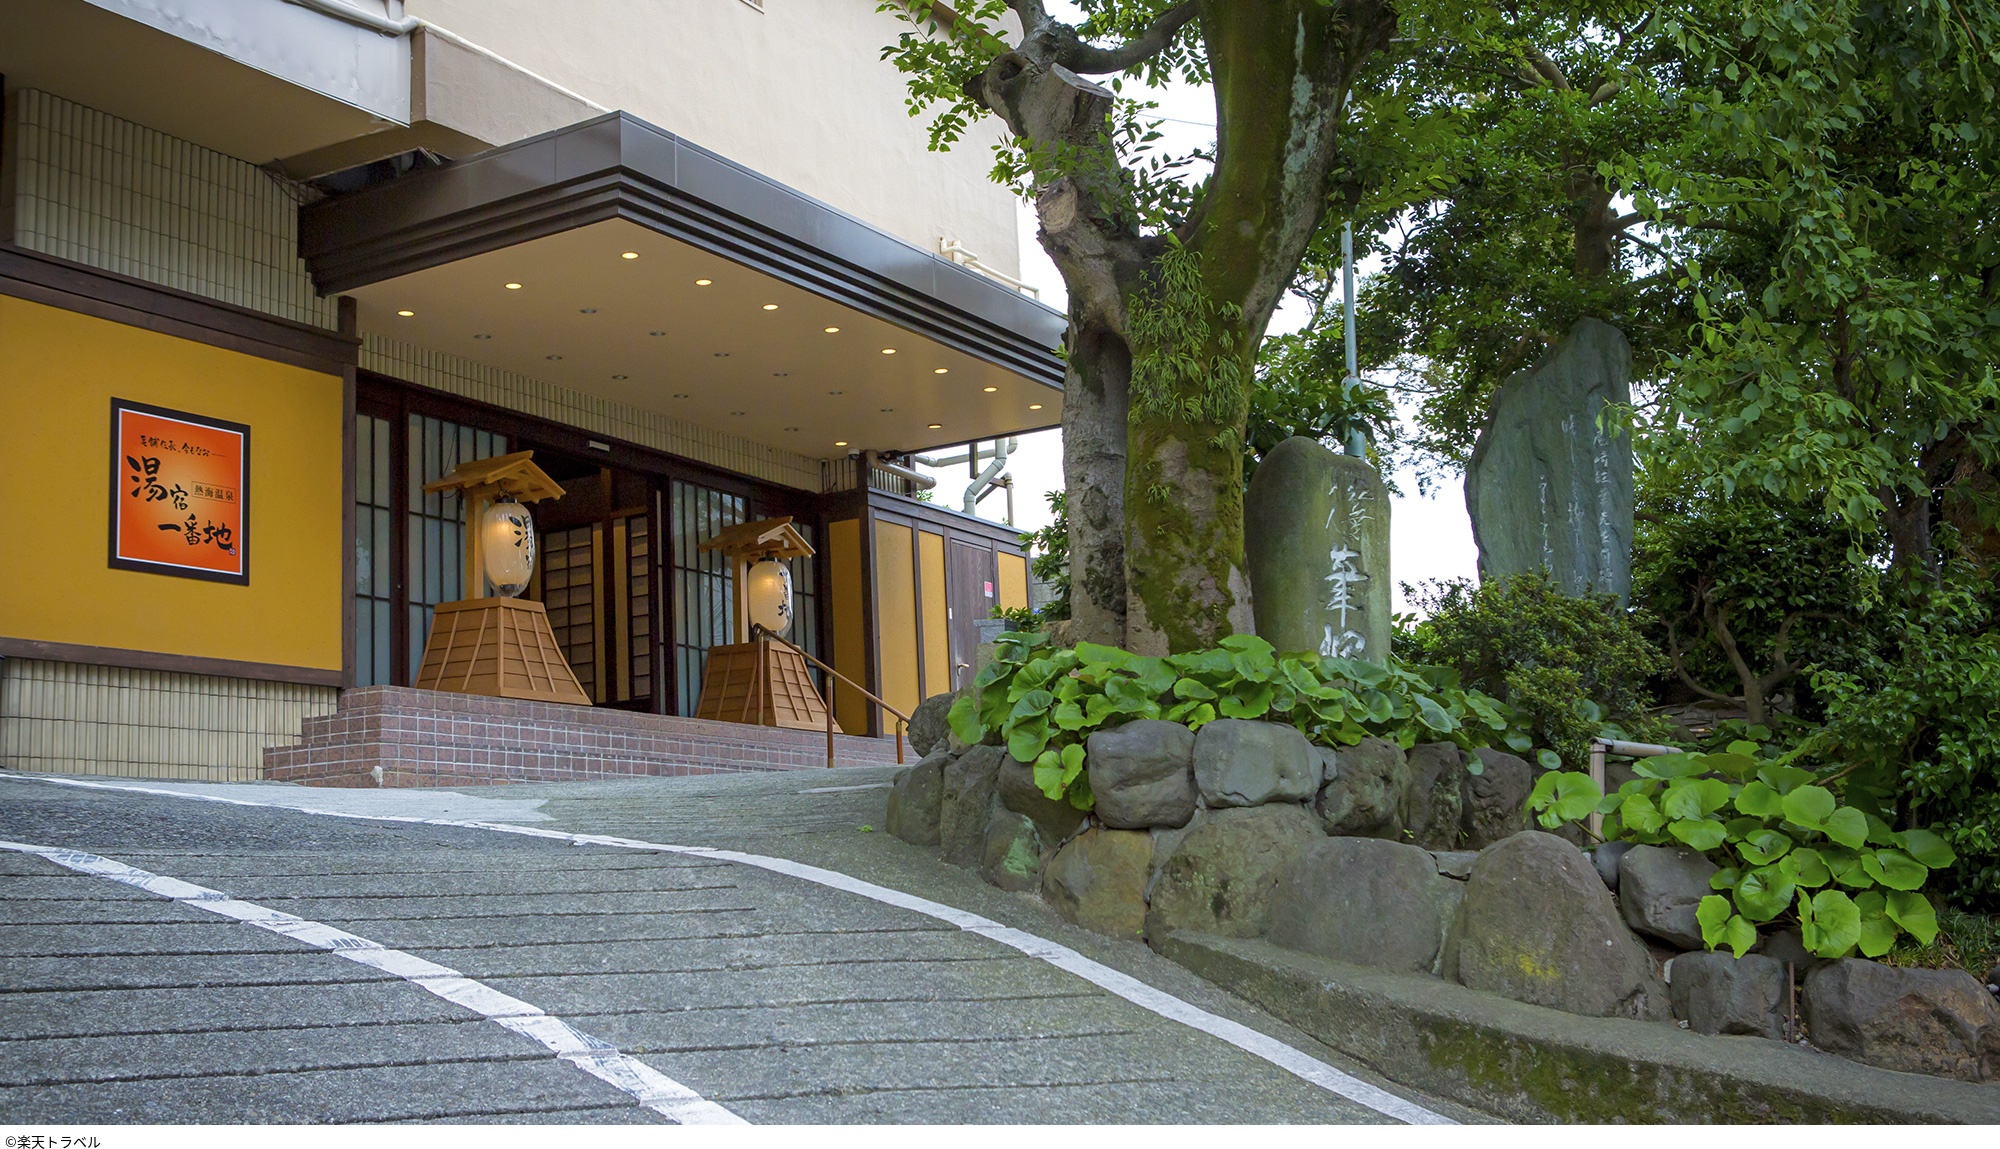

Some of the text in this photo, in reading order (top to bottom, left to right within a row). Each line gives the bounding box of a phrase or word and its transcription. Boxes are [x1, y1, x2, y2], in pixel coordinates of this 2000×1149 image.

[126, 455, 189, 511] 湯宿
[194, 484, 235, 501] 熱海温泉
[157, 513, 234, 550] 一番地
